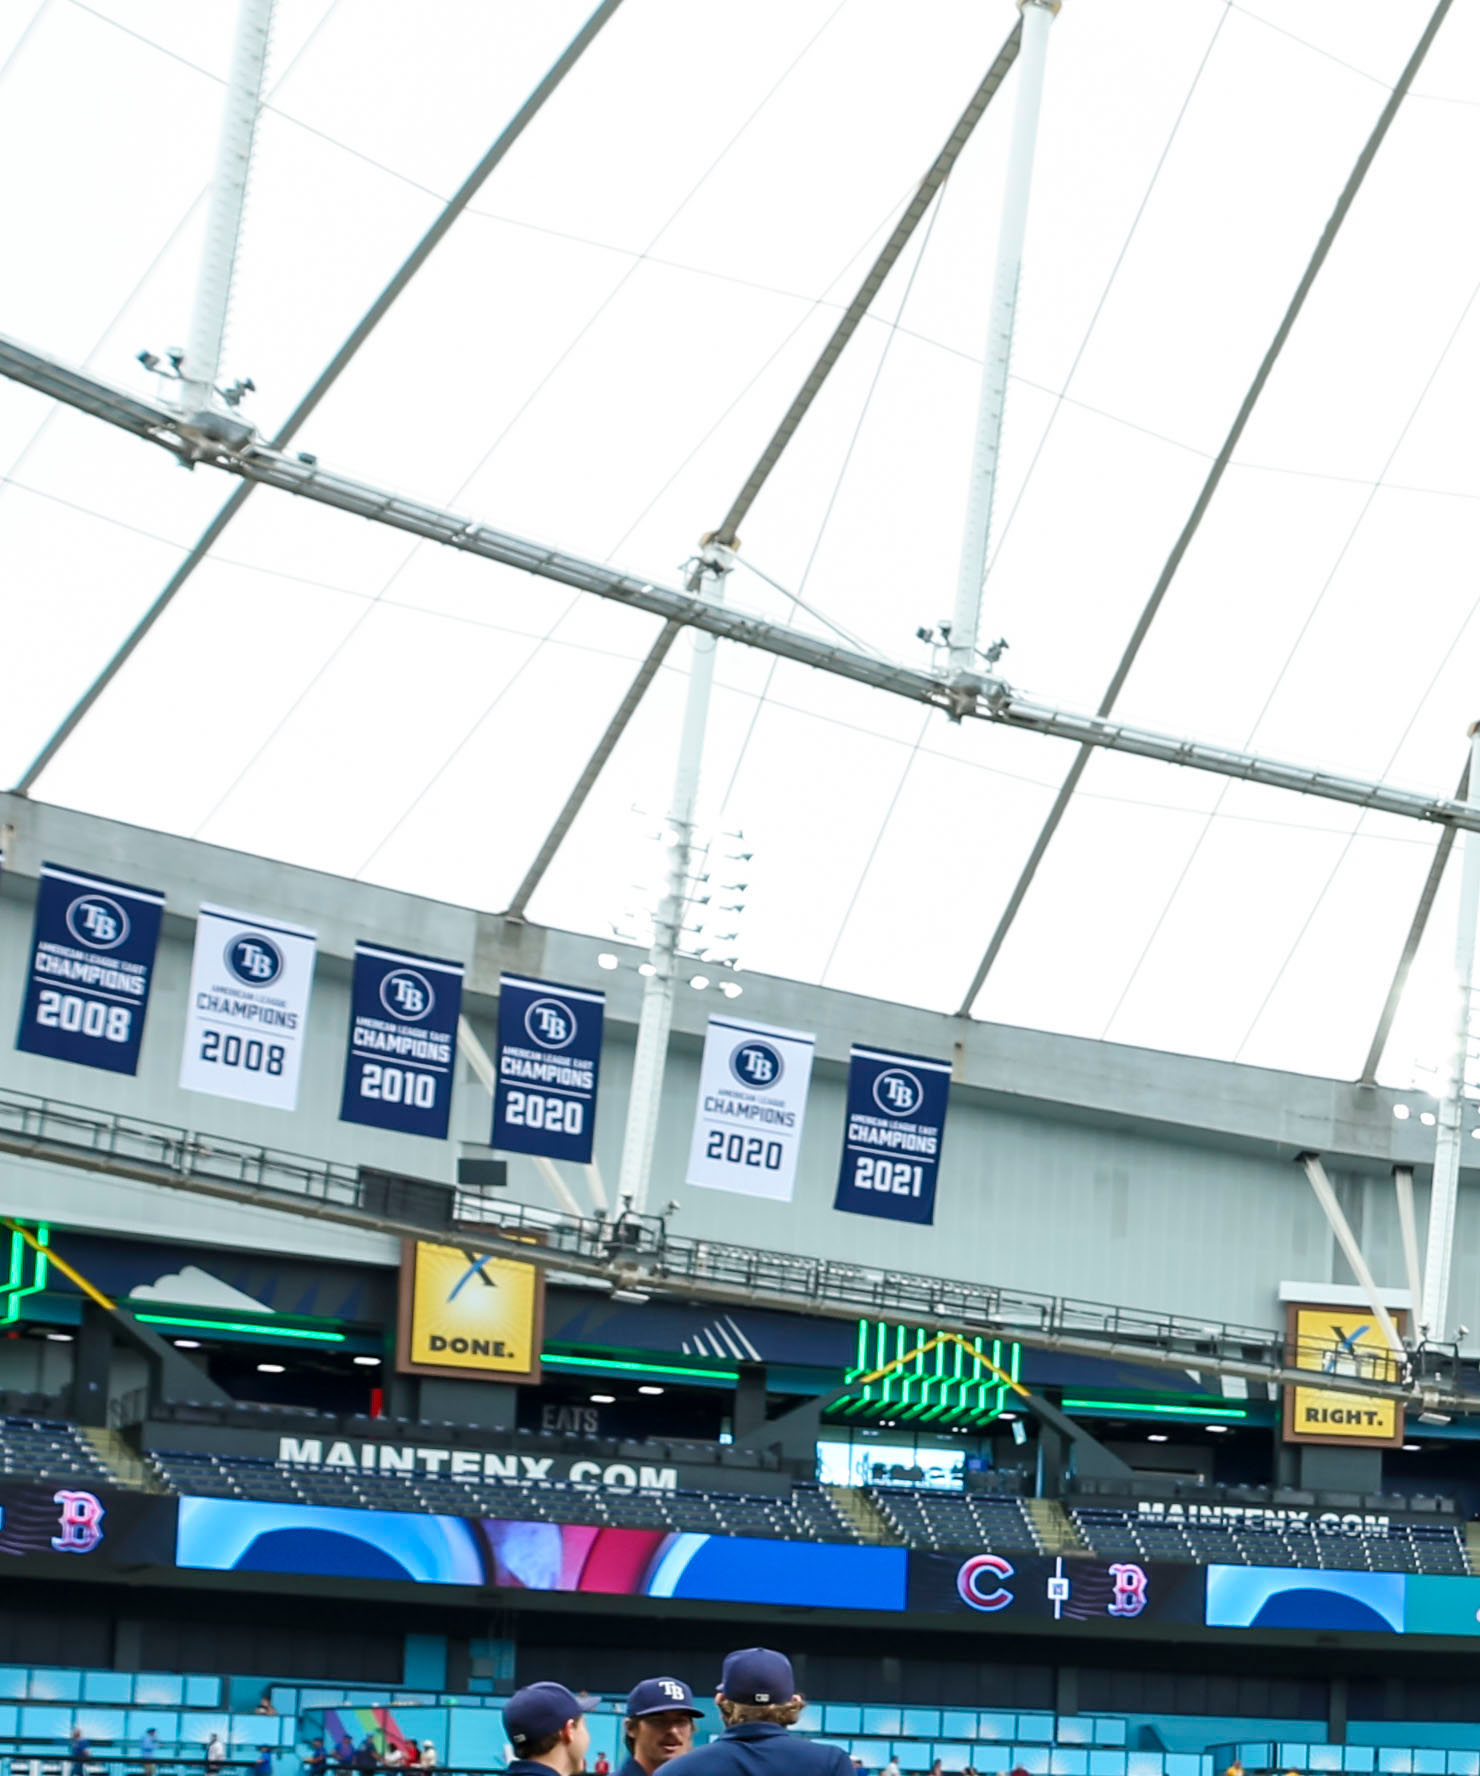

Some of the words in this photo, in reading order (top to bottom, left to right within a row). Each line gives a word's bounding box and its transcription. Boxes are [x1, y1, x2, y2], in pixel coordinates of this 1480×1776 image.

[79, 903, 117, 940] TB
[35, 951, 147, 995] CHAMPIONS
[237, 942, 273, 979] TB
[197, 992, 299, 1030] CHAMPIONS
[391, 977, 424, 1012] TB
[37, 990, 132, 1043] 2008
[535, 1007, 568, 1041] TB
[200, 1030, 286, 1077] 2008
[353, 1027, 451, 1063] CHAMPIONS
[501, 1056, 594, 1090] CHAMPIONS
[742, 1049, 773, 1081] TB
[360, 1063, 436, 1109] 2010
[883, 1076, 914, 1108] TB
[505, 1091, 584, 1135] 2020
[704, 1096, 796, 1128] CHAMPIONS
[706, 1130, 783, 1171] 2020
[848, 1123, 938, 1155] CHAMPIONS
[854, 1157, 924, 1198] 2021
[429, 1335, 516, 1361] DONE.
[541, 1405, 599, 1432] EATS
[1305, 1406, 1385, 1428] RIGHT.
[51, 1488, 108, 1554] B
[956, 1553, 1015, 1612] C
[1107, 1561, 1149, 1618] B
[658, 1681, 685, 1701] TB
